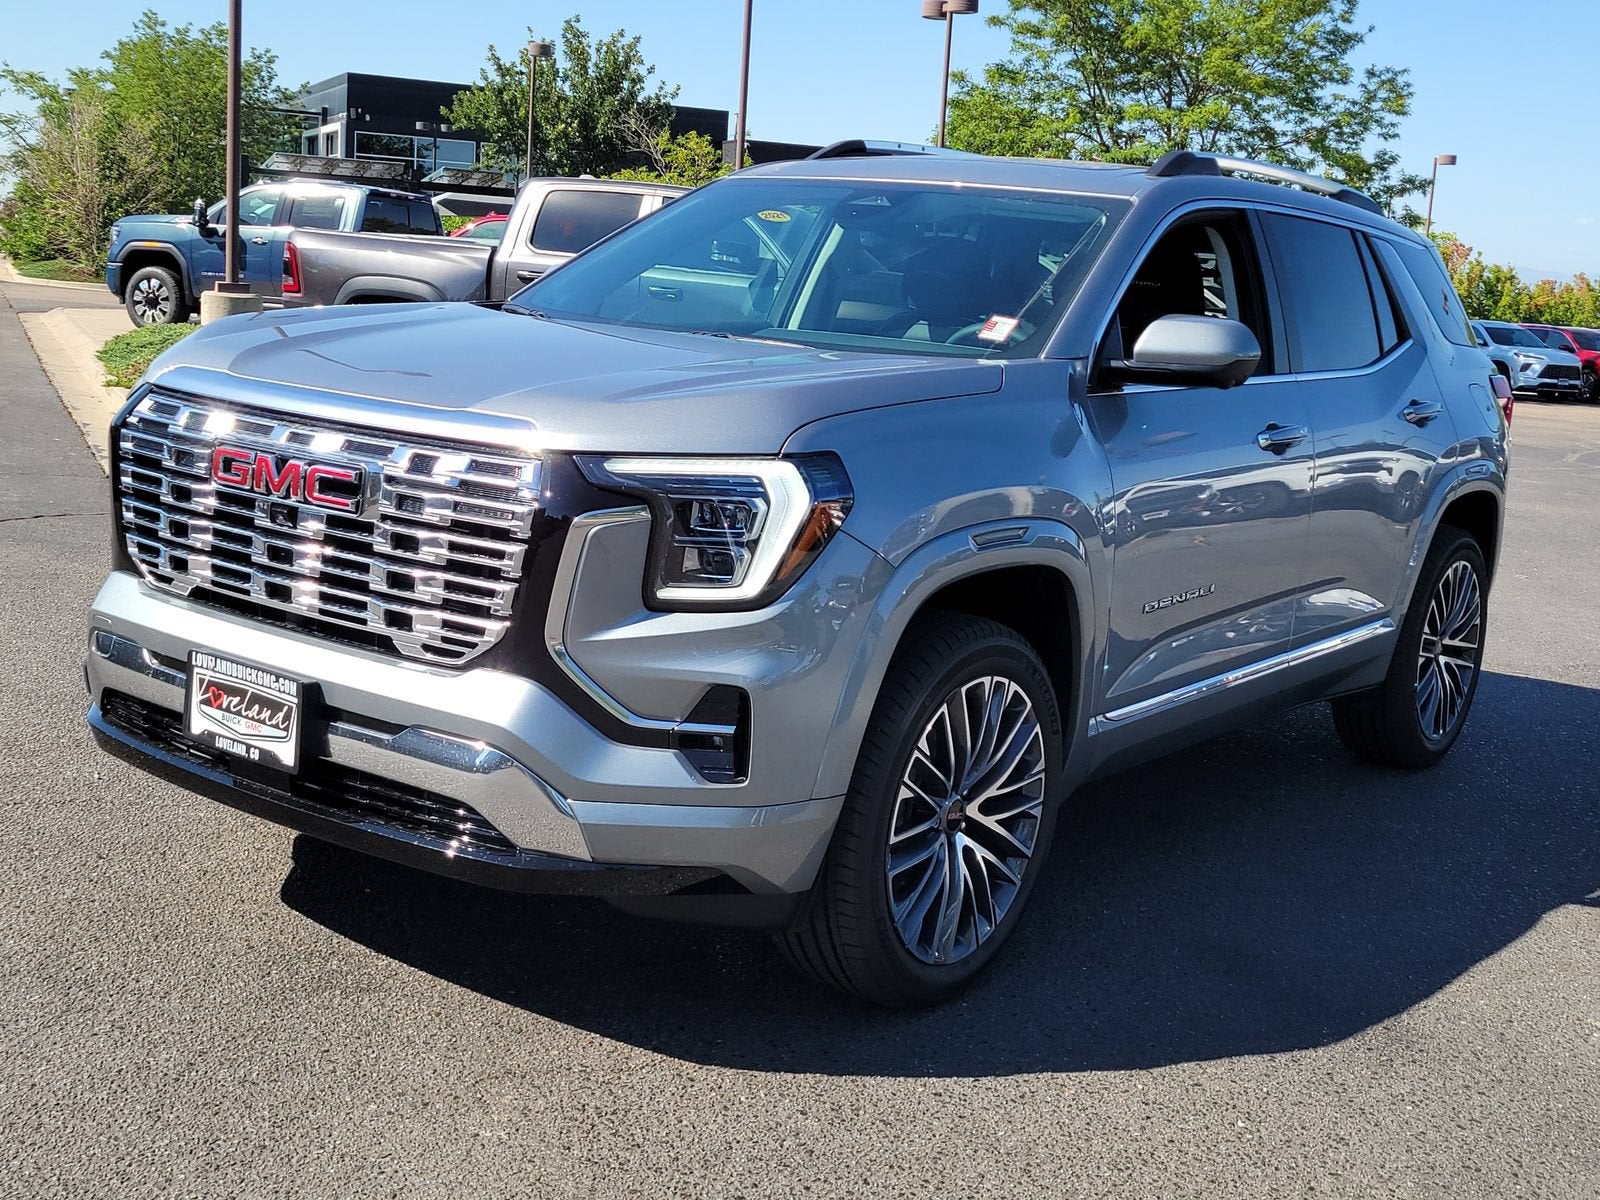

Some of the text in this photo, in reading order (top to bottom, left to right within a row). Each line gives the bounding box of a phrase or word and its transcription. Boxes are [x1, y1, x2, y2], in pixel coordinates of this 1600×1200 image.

[211, 446, 357, 509] GMC
[1142, 583, 1215, 614] DENALI
[191, 651, 298, 696] LOVELANDBUICKGMC.COM
[221, 712, 263, 733] BUICK GMC
[215, 735, 260, 760] LOVELAND, CO
